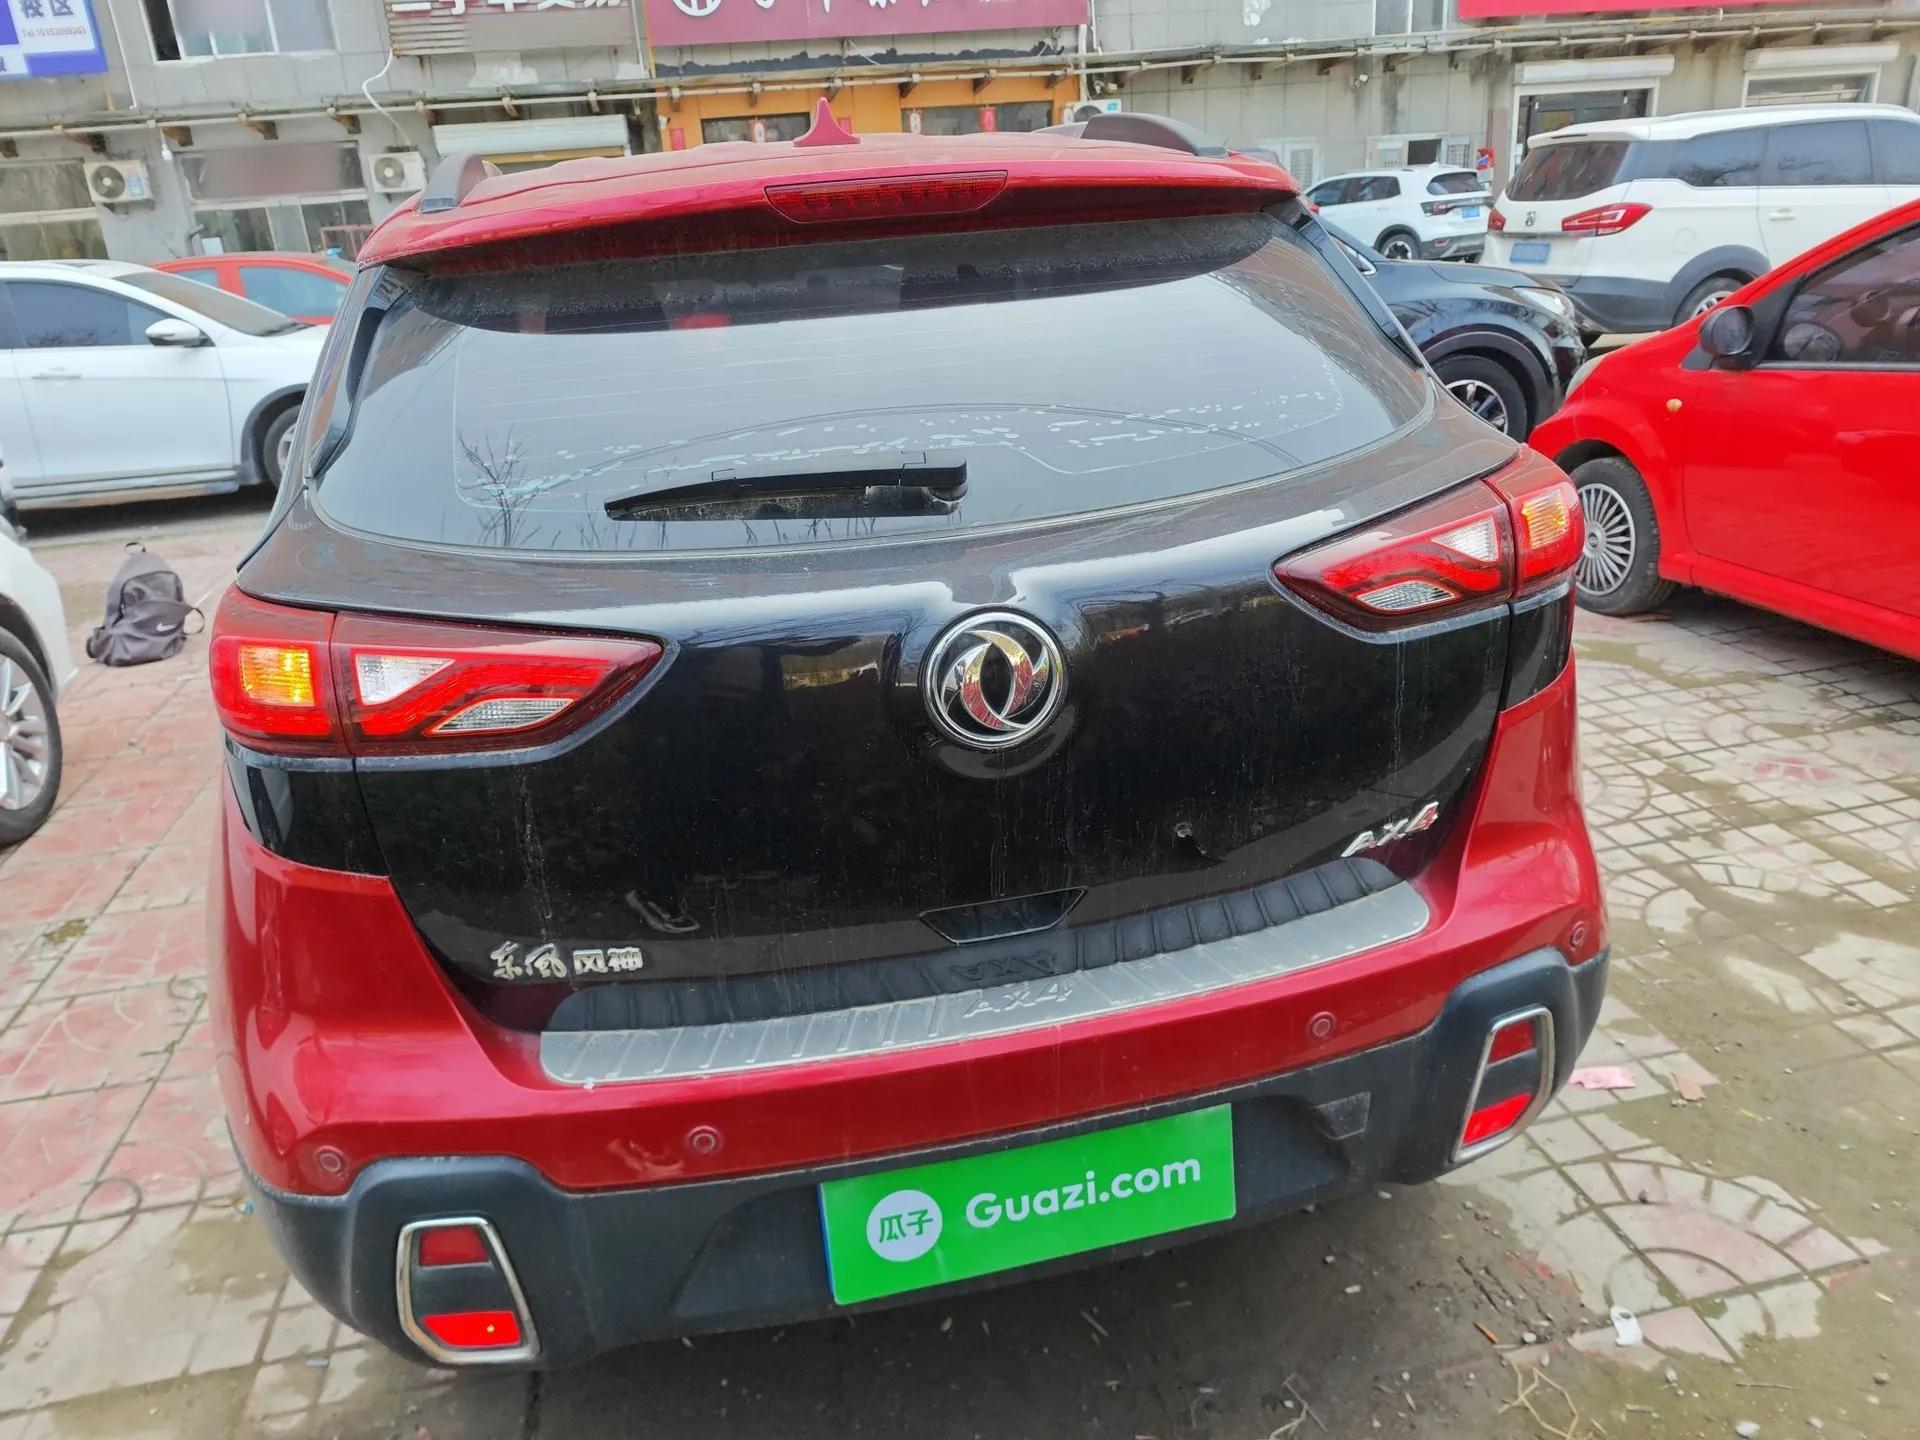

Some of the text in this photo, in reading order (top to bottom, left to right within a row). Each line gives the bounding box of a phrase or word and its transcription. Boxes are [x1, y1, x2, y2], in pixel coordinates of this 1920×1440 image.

[1341, 801, 1440, 857] AX4
[962, 980, 1074, 1019] AX4
[878, 1157, 1201, 1244] 瓜子 Guazi.com
